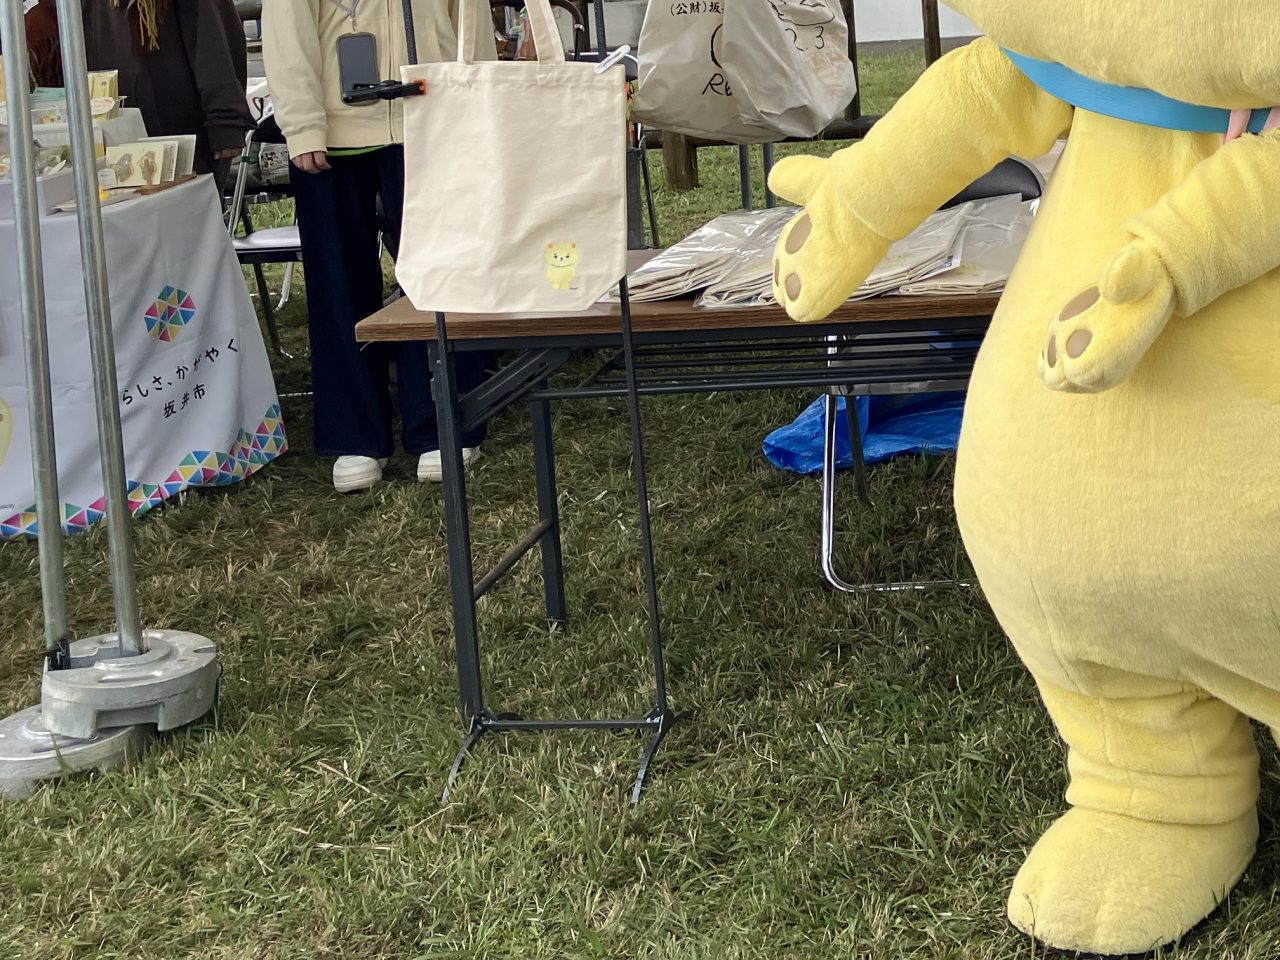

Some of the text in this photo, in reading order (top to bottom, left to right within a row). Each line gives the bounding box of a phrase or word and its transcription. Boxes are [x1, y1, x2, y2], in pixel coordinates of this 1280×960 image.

[670, 0, 724, 17] (公財)坂
[163, 384, 206, 419] 坂井市
